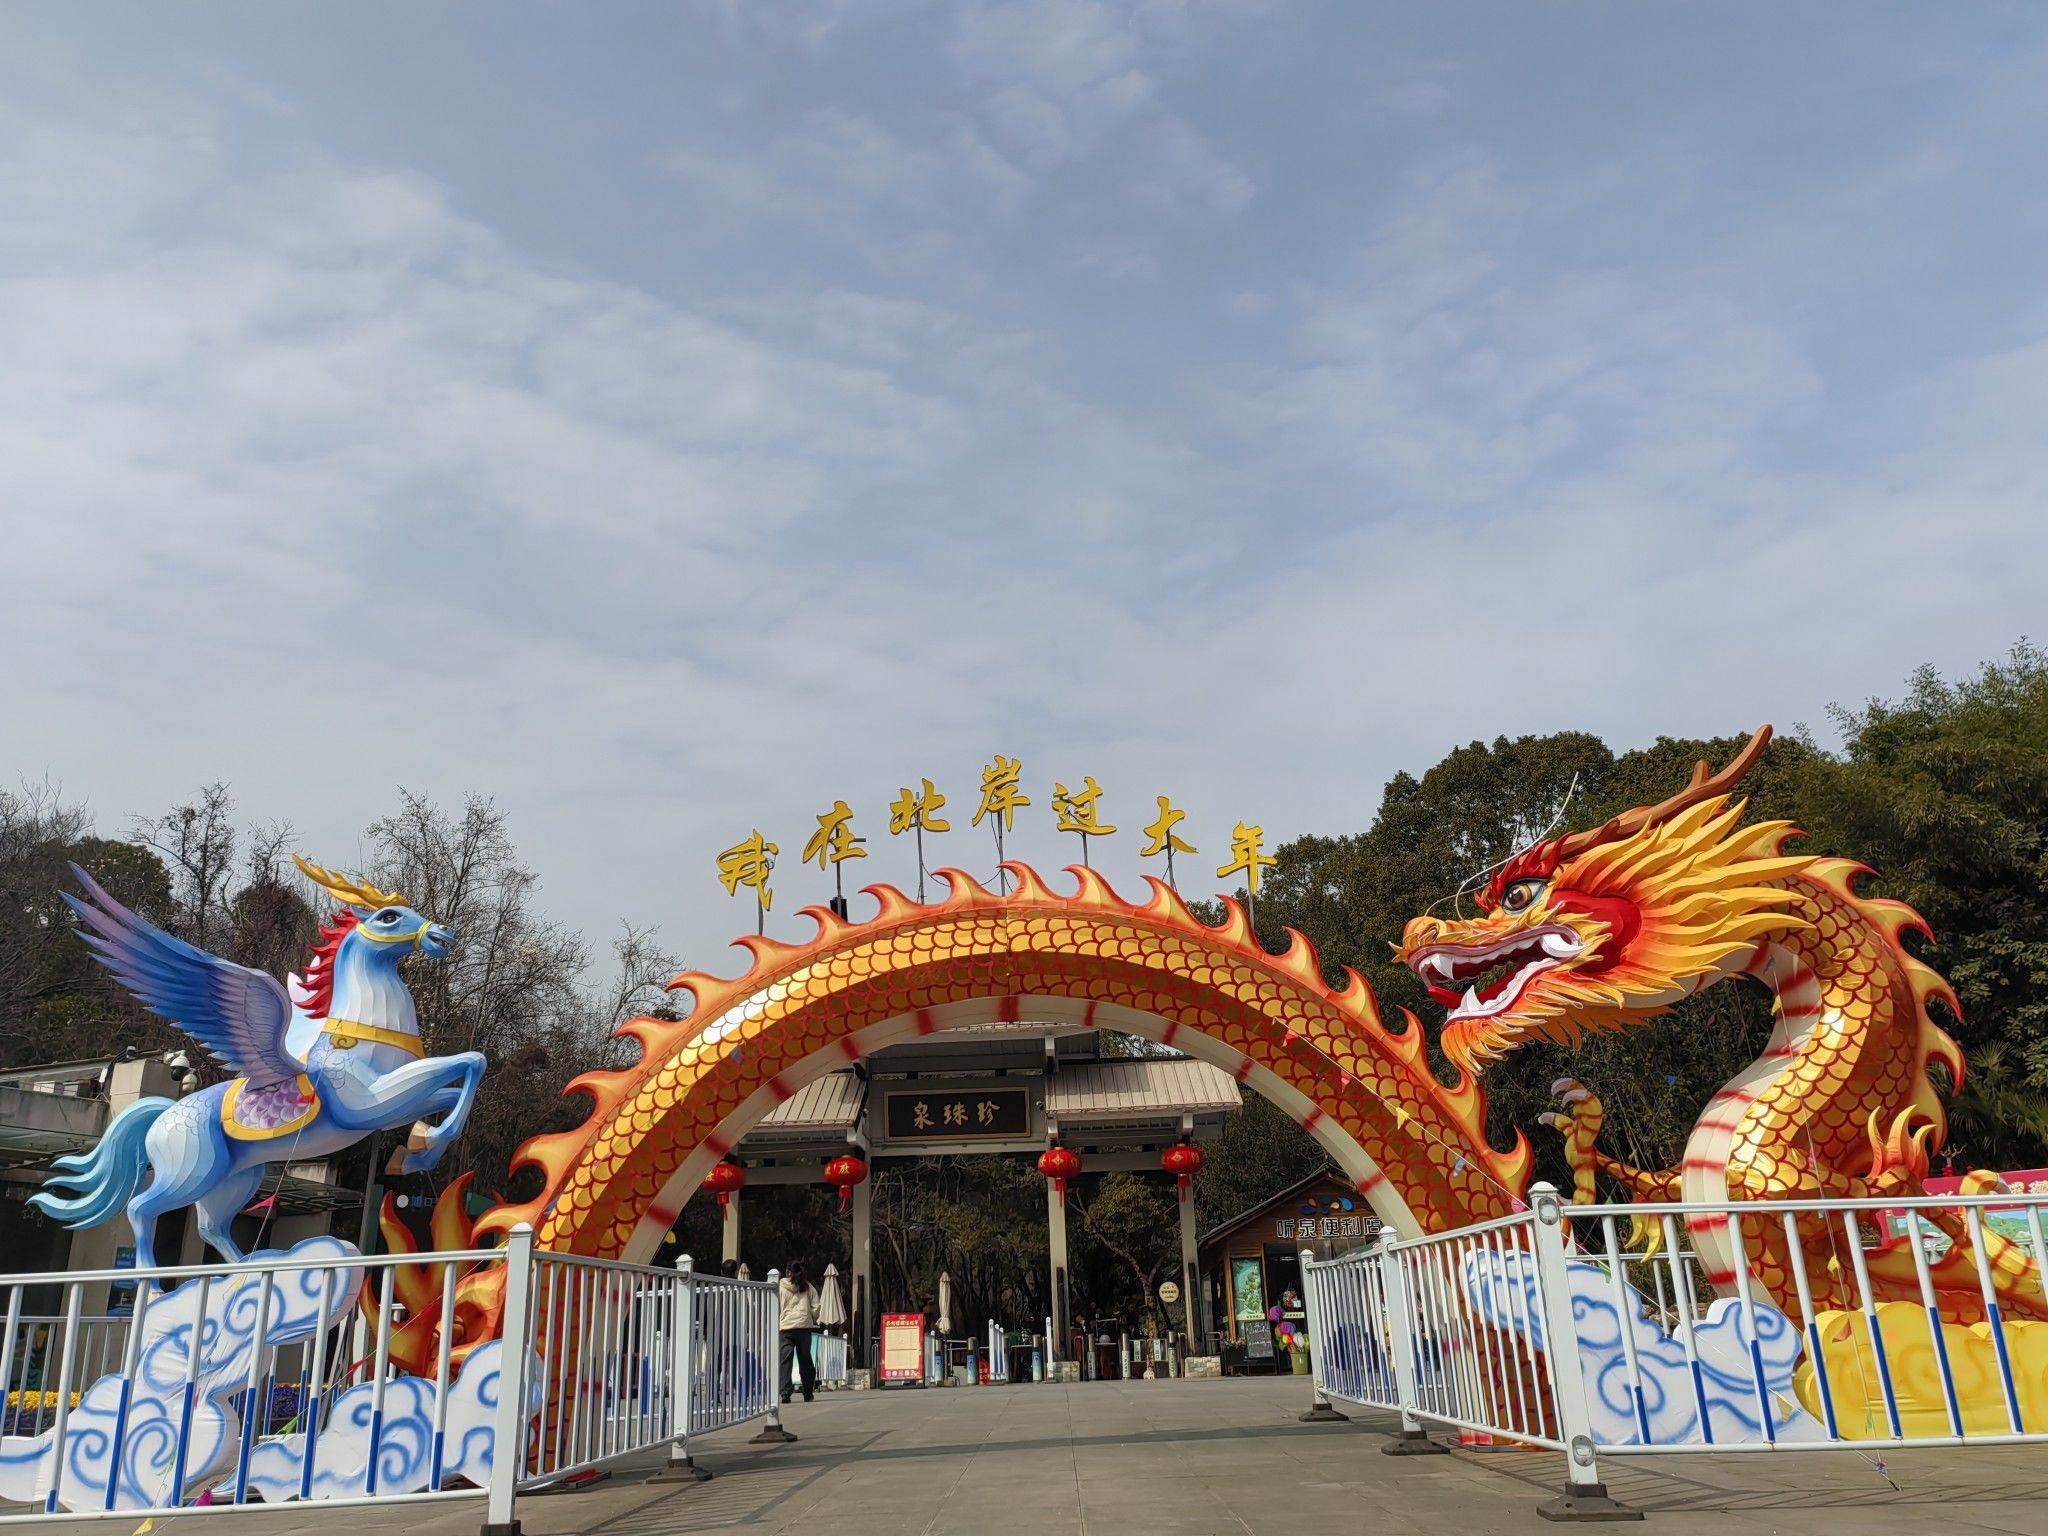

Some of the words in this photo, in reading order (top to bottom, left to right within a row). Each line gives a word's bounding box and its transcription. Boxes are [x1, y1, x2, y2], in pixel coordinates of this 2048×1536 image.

[717, 756, 1277, 911] 我在北岸过大年
[1277, 1216, 1381, 1238] 听泉便利店
